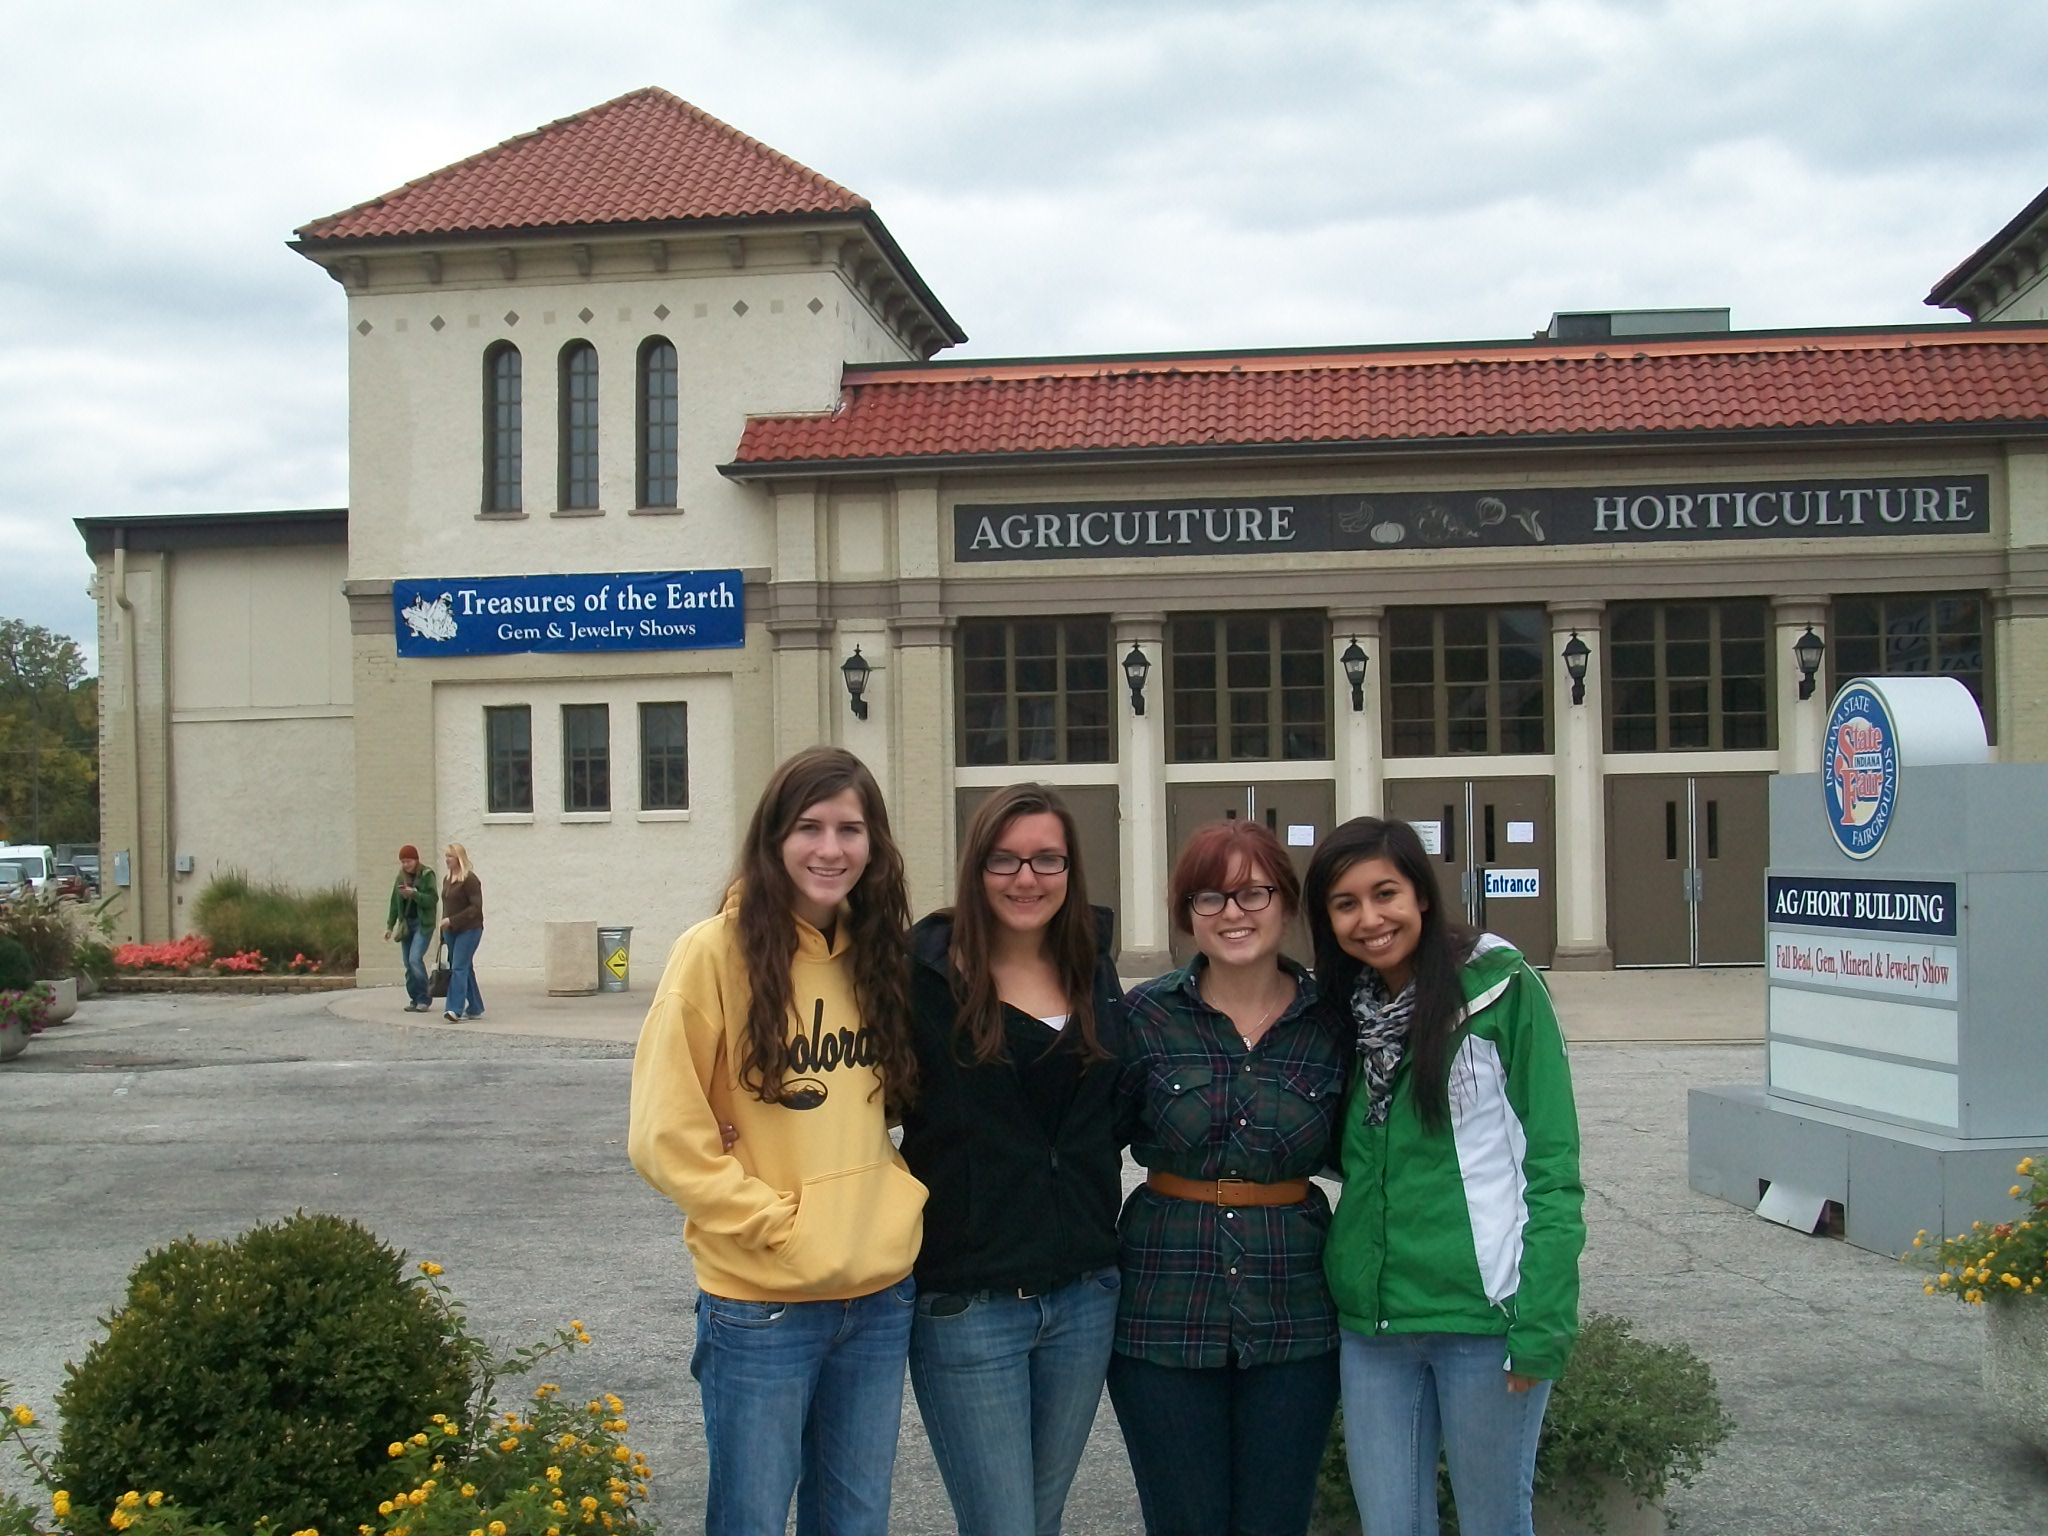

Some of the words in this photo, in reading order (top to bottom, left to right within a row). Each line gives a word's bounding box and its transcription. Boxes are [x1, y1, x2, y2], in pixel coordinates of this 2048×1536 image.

[969, 506, 1297, 550] AGRICULTURE
[1593, 486, 1974, 532] HORTICULTURE
[458, 590, 575, 615] Treasures
[584, 585, 610, 612] of
[617, 584, 657, 611] the
[666, 582, 735, 609] Earth
[497, 623, 541, 640] Gem
[546, 622, 565, 639] &
[569, 620, 634, 641] Jewelry
[639, 619, 696, 637] Shows
[1826, 713, 1844, 787] INDIANA
[1843, 695, 1870, 717] STATE
[1834, 722, 1883, 772] State
[1854, 756, 1881, 768] INDIANA
[1840, 768, 1883, 826] Fair
[1852, 747, 1894, 847] FAIRGROUNDS
[1485, 873, 1537, 893] Entrance
[1775, 889, 1852, 918] AG/HORT
[1854, 892, 1945, 923] BUILDING
[1776, 944, 1791, 969] Fall
[1793, 945, 1814, 977] Bead,
[1815, 947, 1839, 980] Gem,
[1840, 949, 1873, 978] Mineral
[1875, 952, 1883, 977] &
[1885, 953, 1920, 989] Jewelry
[1922, 956, 1950, 985] Show
